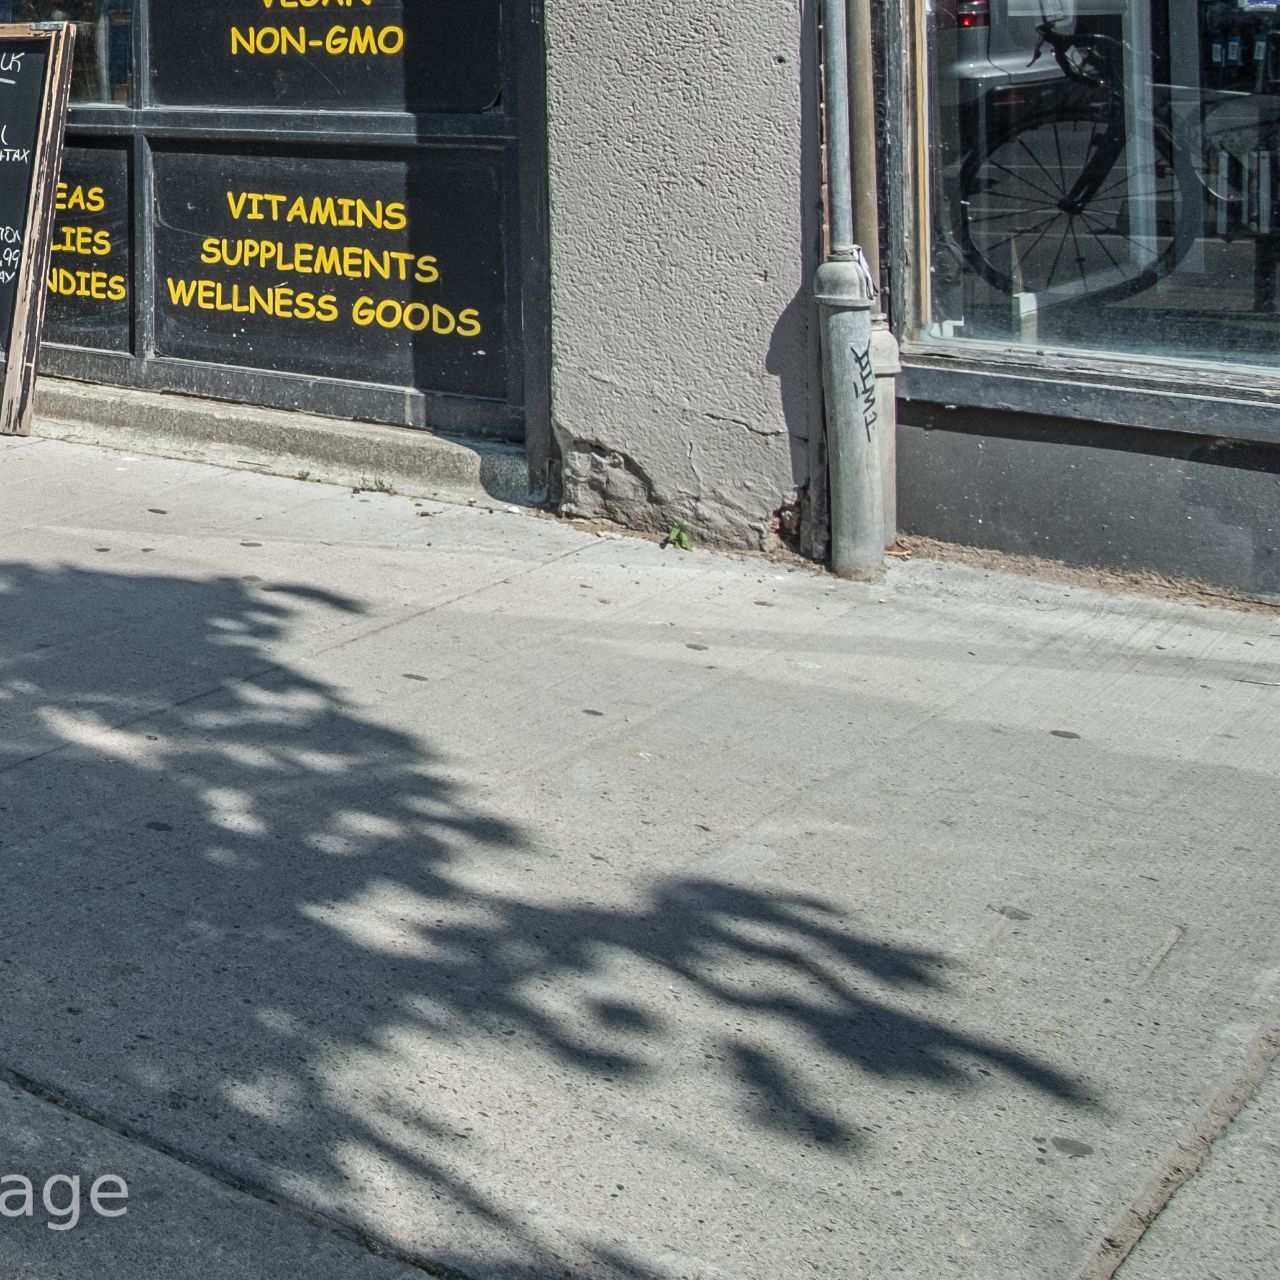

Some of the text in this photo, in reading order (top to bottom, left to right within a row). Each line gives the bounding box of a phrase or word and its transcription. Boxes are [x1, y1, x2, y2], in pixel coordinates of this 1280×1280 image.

[230, 25, 404, 55] NON-GMO
[55, 182, 105, 212] EAS
[227, 191, 407, 230] VITAMINS
[200, 238, 439, 283] SUPPLEMENTS
[167, 277, 482, 336] WELLNESS GOODS
